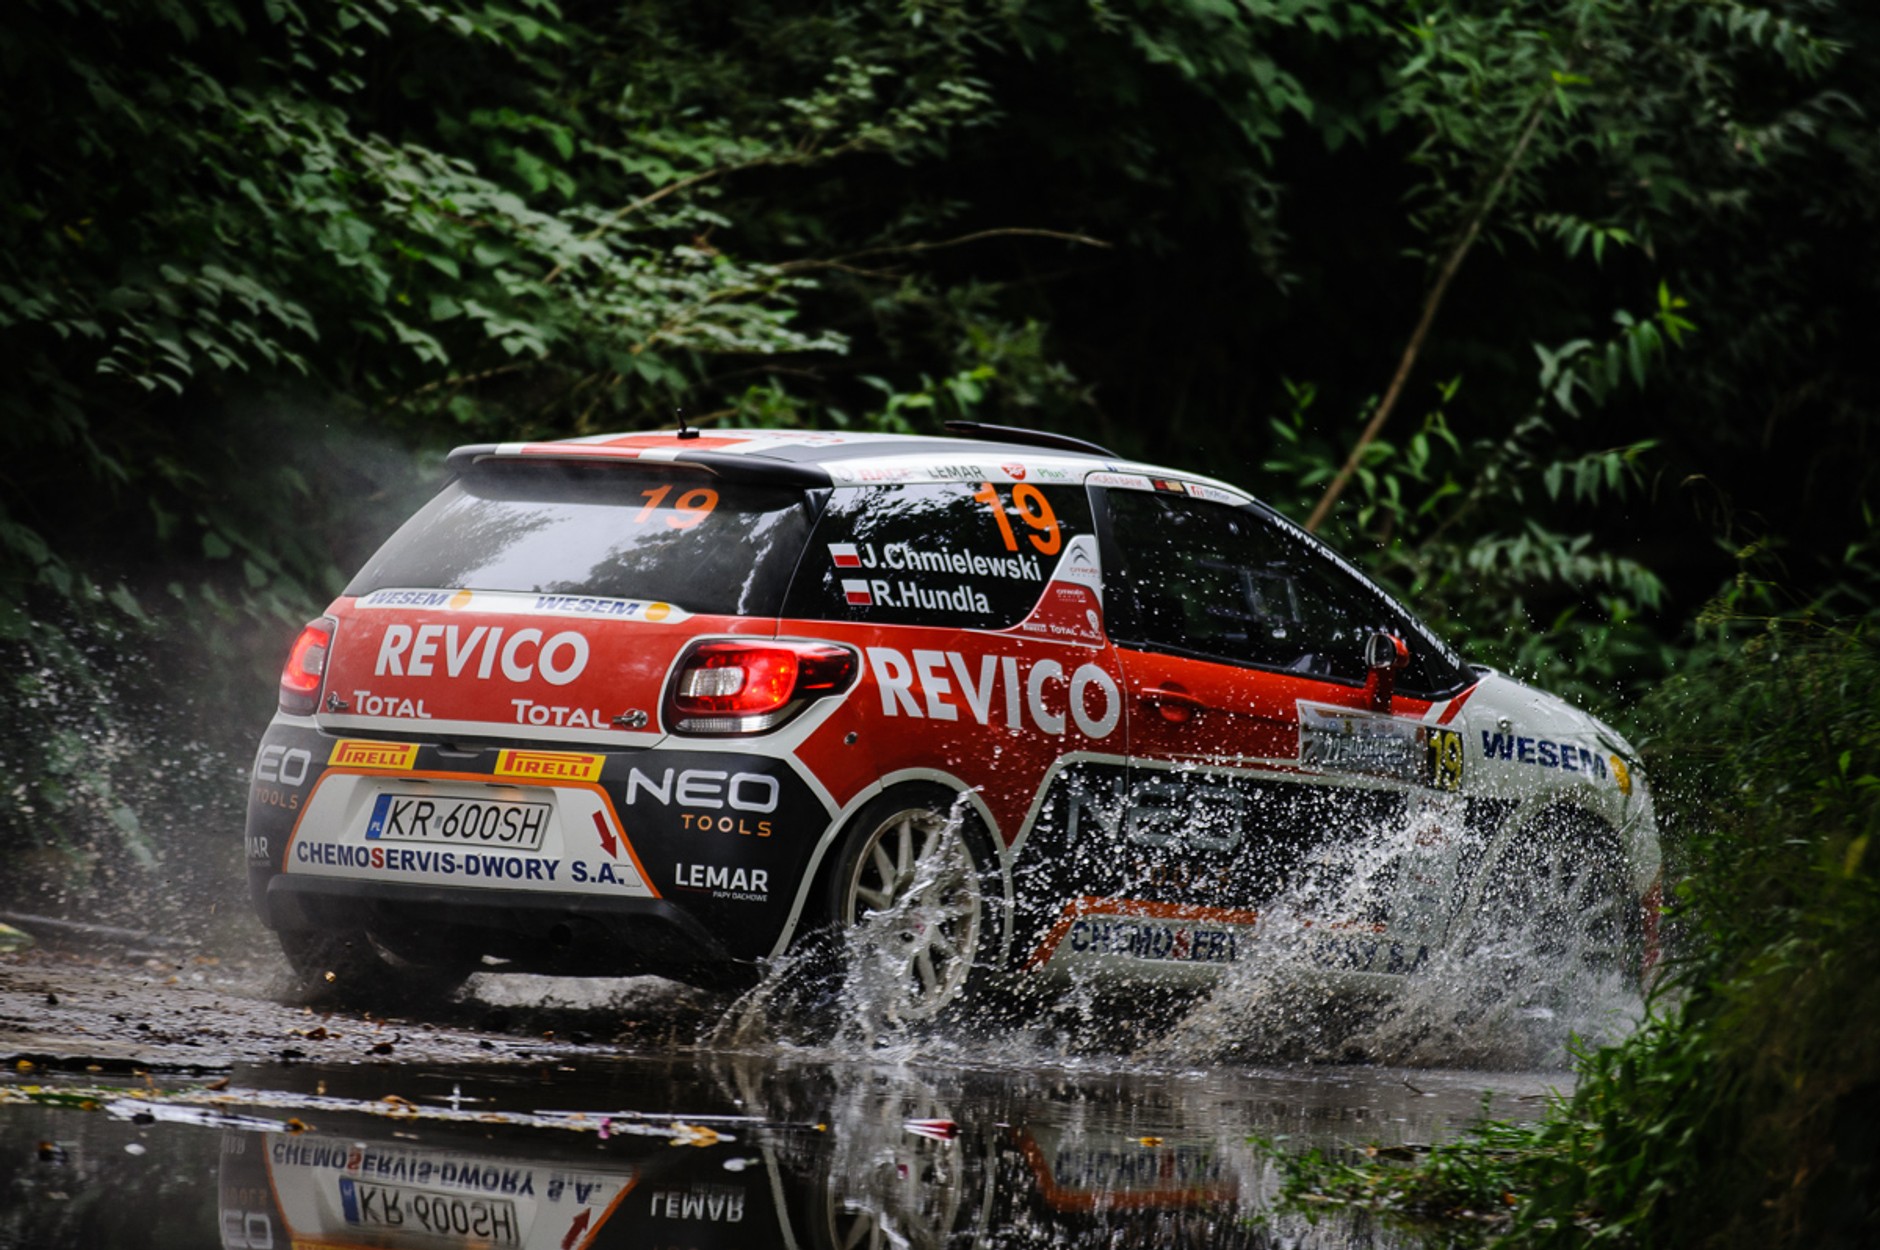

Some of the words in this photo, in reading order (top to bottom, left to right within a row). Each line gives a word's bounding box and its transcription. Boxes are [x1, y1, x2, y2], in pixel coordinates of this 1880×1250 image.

[927, 464, 987, 480] LEMAR
[633, 484, 719, 530] 19
[973, 481, 1061, 556] 19
[862, 543, 1042, 581] J.Chmielewski
[366, 592, 450, 607] WESEM
[534, 596, 640, 616] WESEM
[870, 579, 990, 614] R.Hundla
[374, 624, 590, 686] REVICO
[353, 690, 432, 719] TOTAL
[866, 646, 1121, 739] REVICO
[511, 698, 610, 729] TOTAL
[335, 741, 411, 766] PIRELLI
[503, 751, 595, 778] PIRELLI
[1430, 729, 1463, 793] 19
[1481, 730, 1607, 780] WESEM
[255, 787, 298, 810] TOOLS
[625, 767, 780, 814] NEO
[370, 821, 382, 833] PL
[385, 799, 436, 837] KR
[440, 803, 544, 845] 600SH
[681, 814, 772, 838] TOOLS
[1066, 772, 1244, 850] NEO
[297, 841, 560, 881] CHEMOSERVIS-DWORY
[571, 860, 625, 885] S.A.
[675, 862, 769, 893] LEMAR
